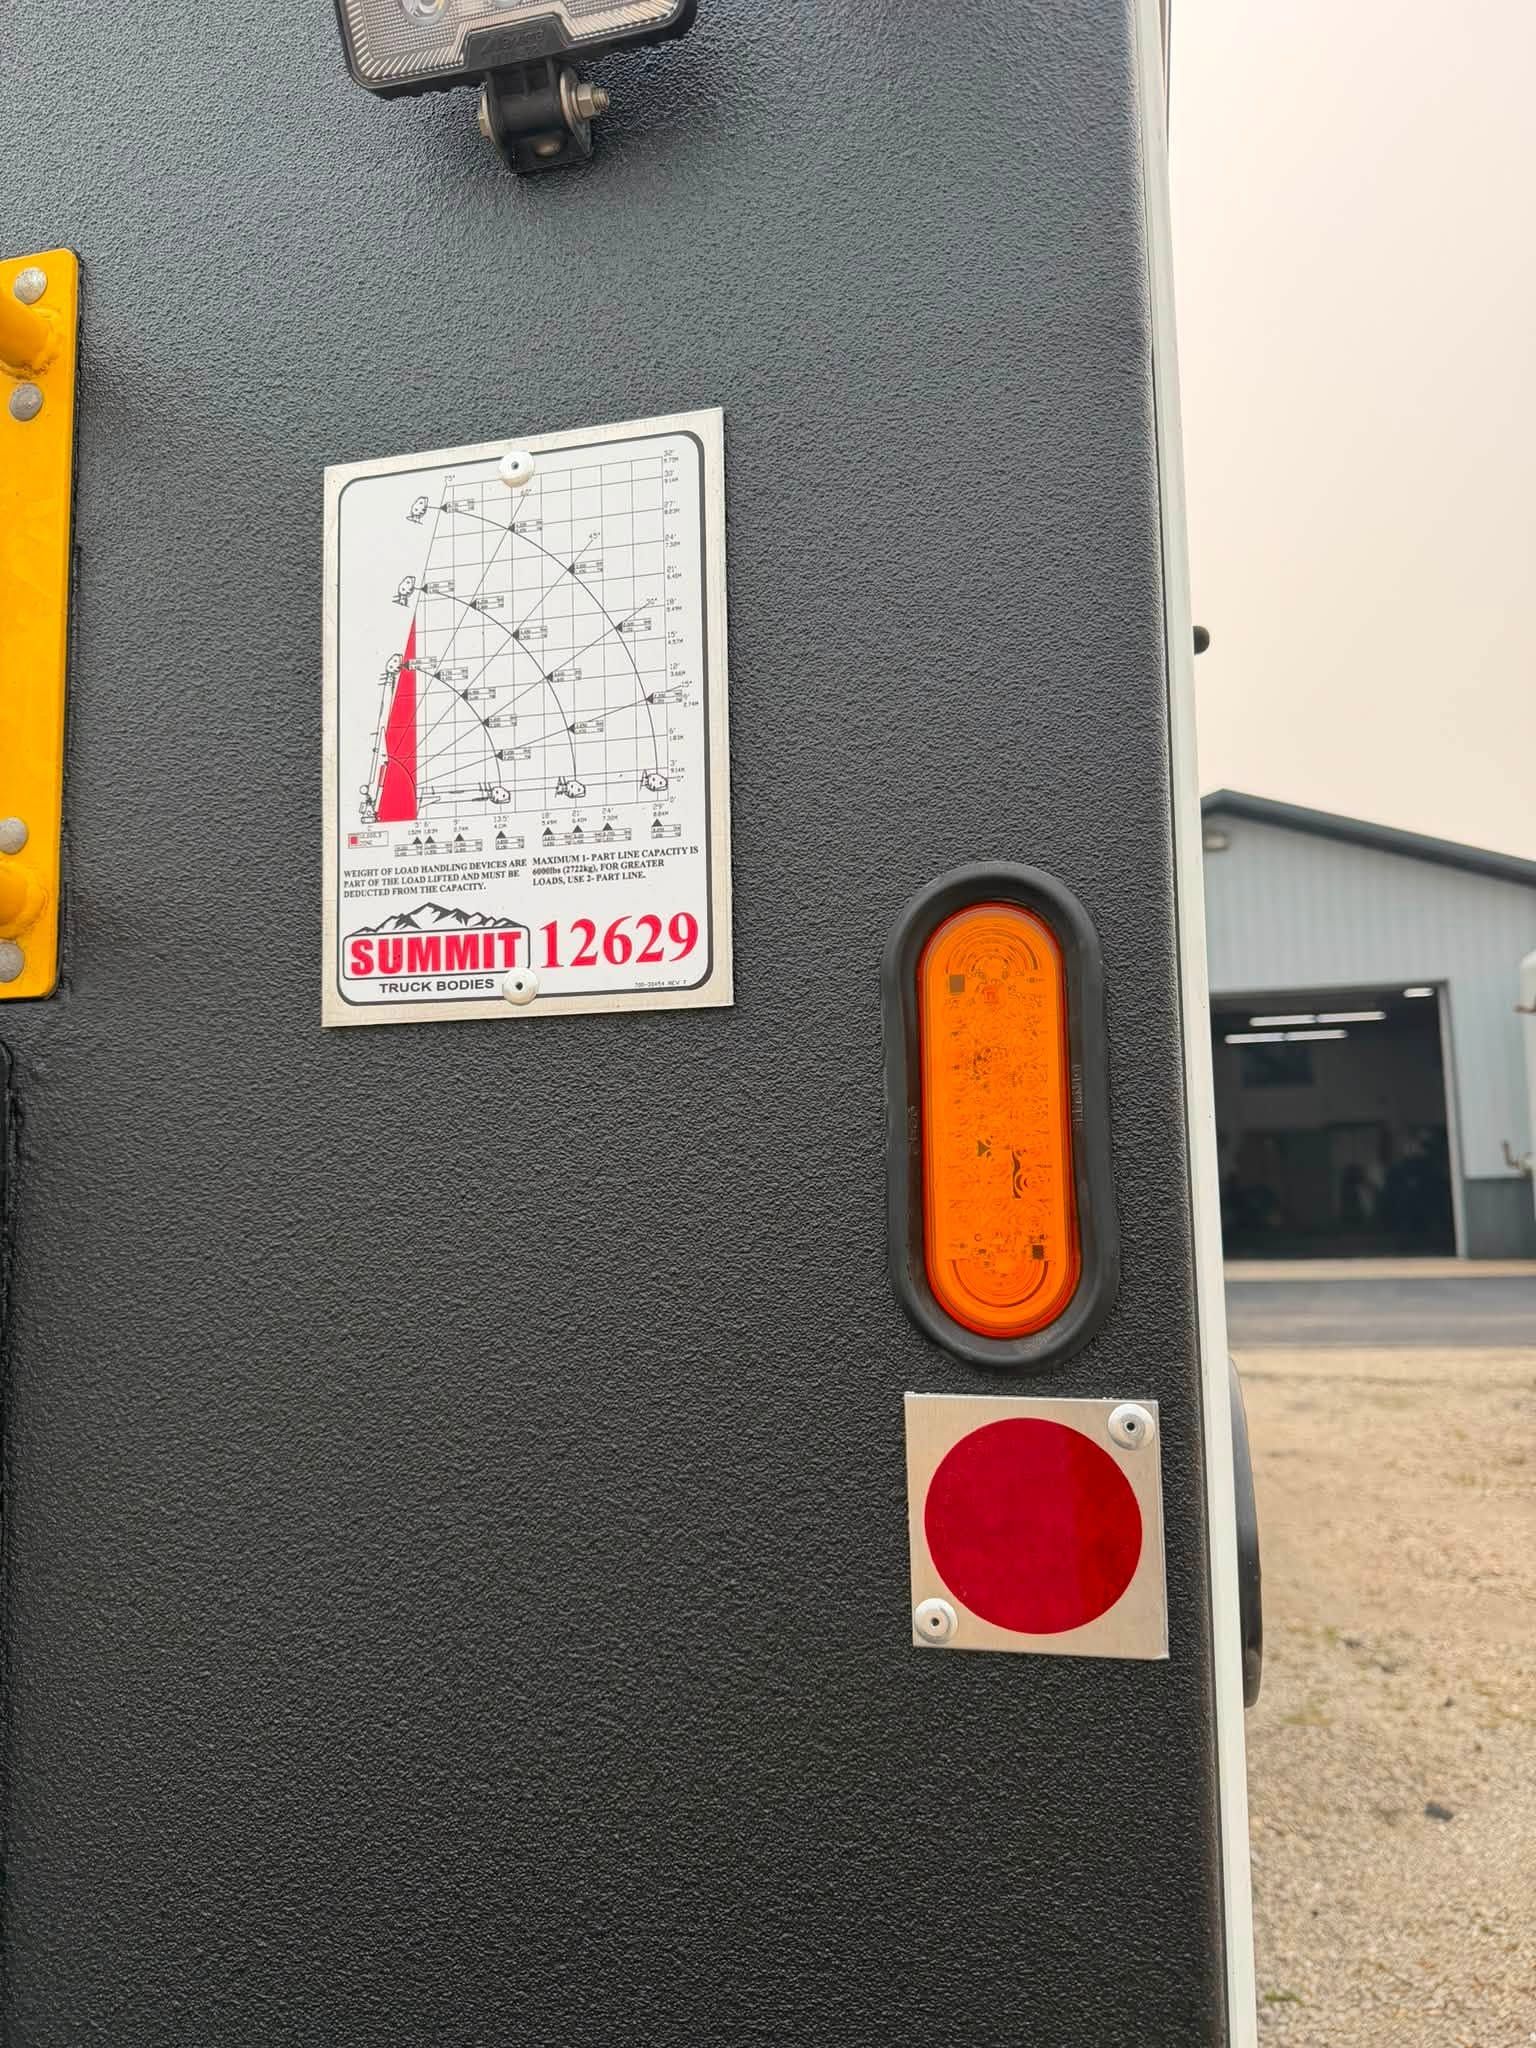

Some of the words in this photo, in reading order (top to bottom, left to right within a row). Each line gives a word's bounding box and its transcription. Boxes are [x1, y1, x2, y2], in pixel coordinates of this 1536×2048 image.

[532, 854, 581, 866] MAXIMUM
[591, 852, 616, 862] PART
[617, 850, 640, 860] LINE
[641, 846, 688, 858] CAPACITY
[689, 845, 699, 854] IS
[344, 869, 379, 878] WEIGHT
[381, 867, 393, 876] OF
[394, 866, 419, 875] LOAD
[421, 863, 468, 874] HANDLING
[469, 860, 508, 871] DEVICES
[509, 858, 527, 868] ARE
[532, 865, 561, 875] 6000lbs
[600, 862, 619, 871] FOR
[620, 858, 665, 870] GREATER
[344, 879, 365, 888] PART
[368, 878, 379, 887] OF
[382, 877, 400, 886] THE
[401, 875, 425, 885] LOAD
[427, 873, 459, 884] LIFTED
[460, 872, 480, 881] AND
[481, 870, 506, 880] MUST
[508, 869, 520, 878] BE
[532, 876, 566, 887] LOADS,
[567, 874, 585, 884] USE
[596, 872, 620, 882] PART
[622, 870, 646, 880] LINE.
[344, 887, 390, 898] DEDUCTED
[392, 886, 418, 895] FROM
[420, 884, 438, 894] THE
[439, 882, 486, 893] CAPACITY.
[539, 911, 699, 969] 12629
[351, 931, 522, 976] SUMMIT
[379, 981, 432, 994] TRUCK
[436, 978, 495, 992] BODIES
